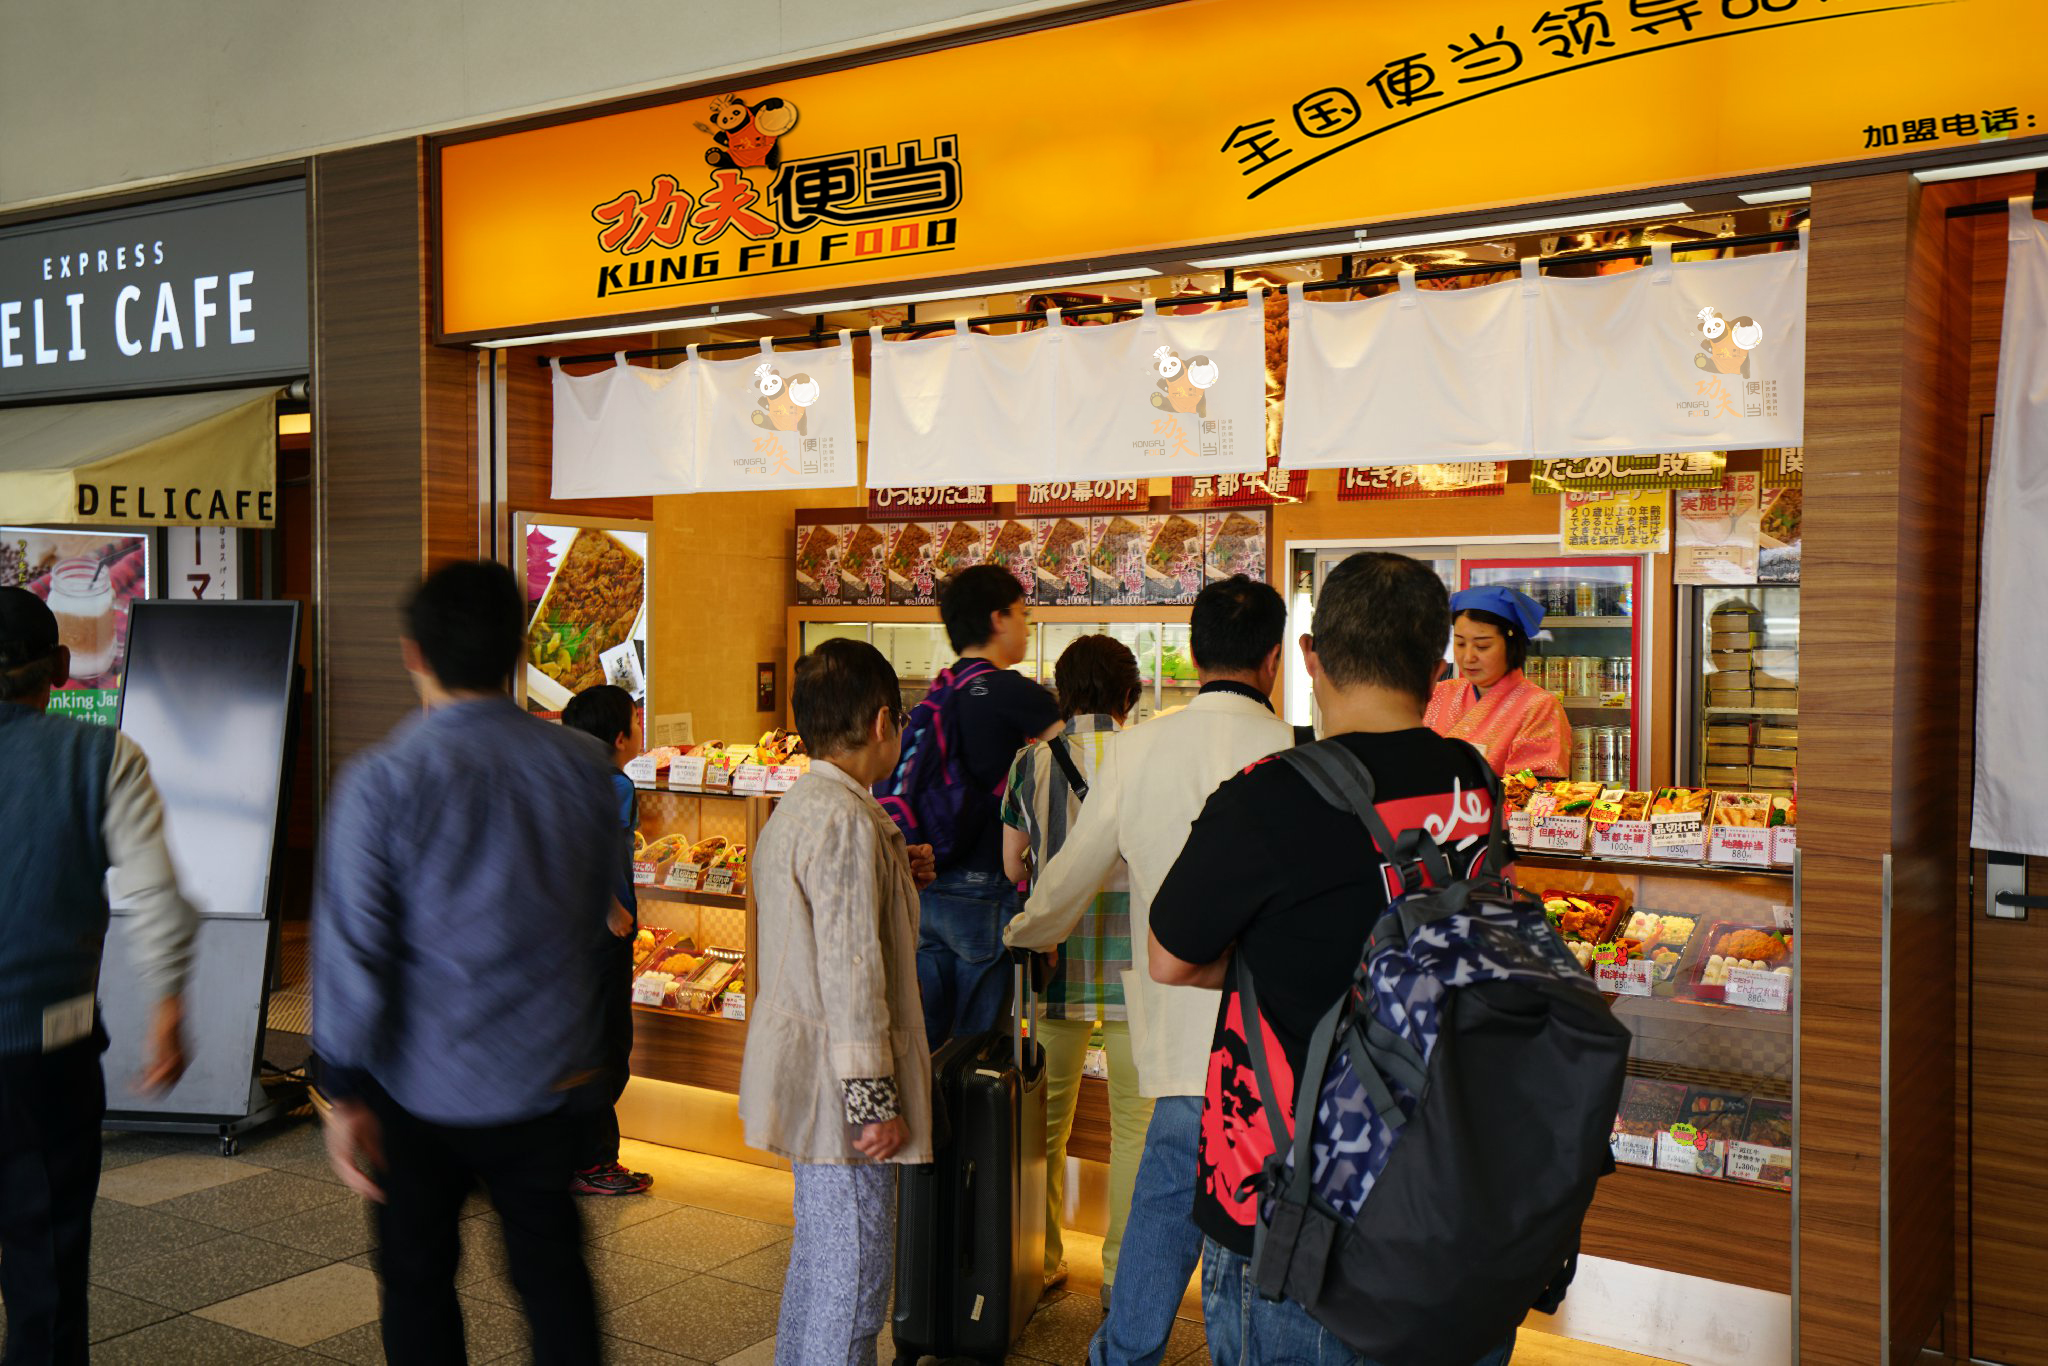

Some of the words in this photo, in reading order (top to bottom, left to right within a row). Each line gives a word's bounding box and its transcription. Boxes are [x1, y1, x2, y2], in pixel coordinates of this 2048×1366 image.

[1220, 0, 1833, 175] 全国便当领导
[592, 134, 962, 255] 功夫便当
[43, 240, 164, 281] EXPRESS
[597, 250, 720, 298] KUNG
[739, 238, 799, 272] FU
[820, 217, 957, 261] FOOD
[115, 270, 255, 357] CAFE
[1676, 401, 1709, 409] KONGFU
[733, 458, 766, 466] KONGFU
[1132, 440, 1165, 448] KONGFU
[78, 483, 273, 521] DELICAFE
[1680, 494, 1736, 512] 実施中
[1654, 821, 1700, 835] 品切れ中
